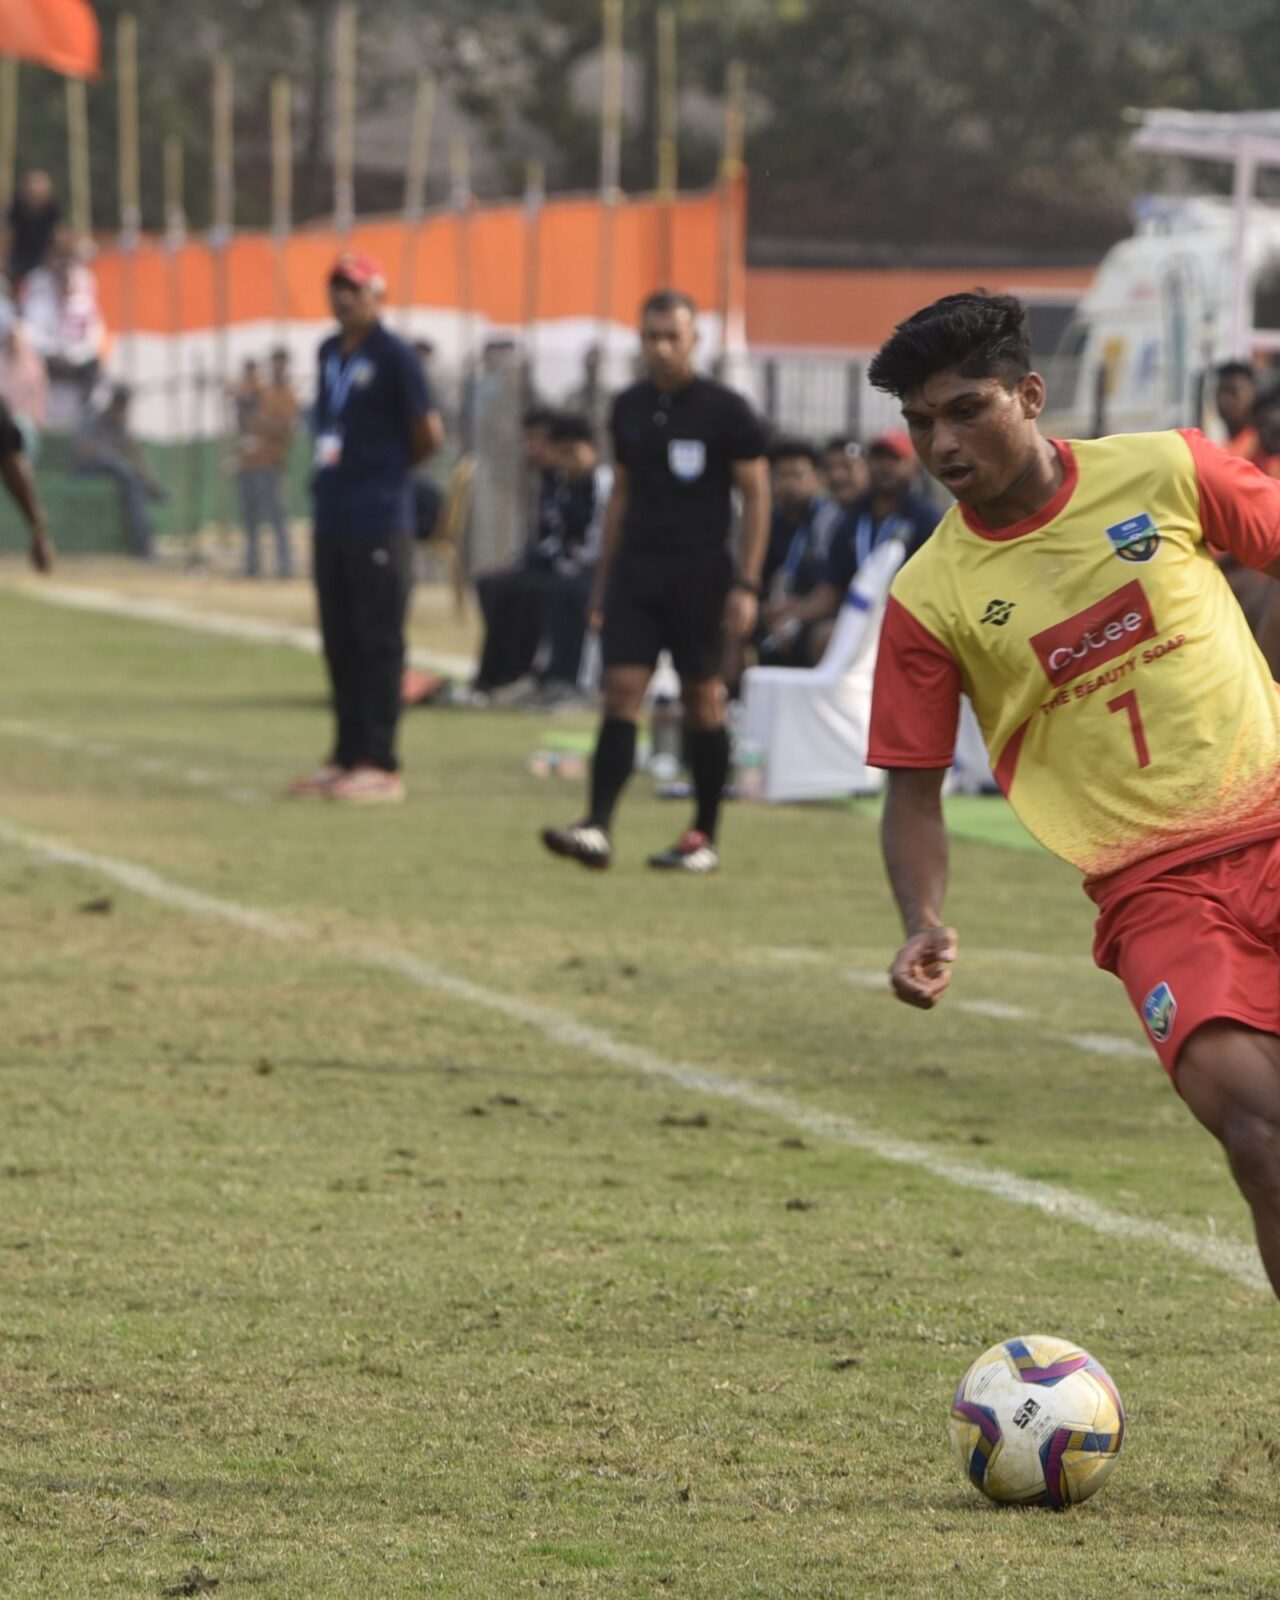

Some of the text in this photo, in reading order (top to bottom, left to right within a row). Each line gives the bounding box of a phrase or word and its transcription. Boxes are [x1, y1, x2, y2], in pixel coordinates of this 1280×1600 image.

[1041, 634, 1186, 716] THE BEAUTY SOAP
[1048, 611, 1142, 671] Cutee
[1107, 688, 1152, 769] 7
